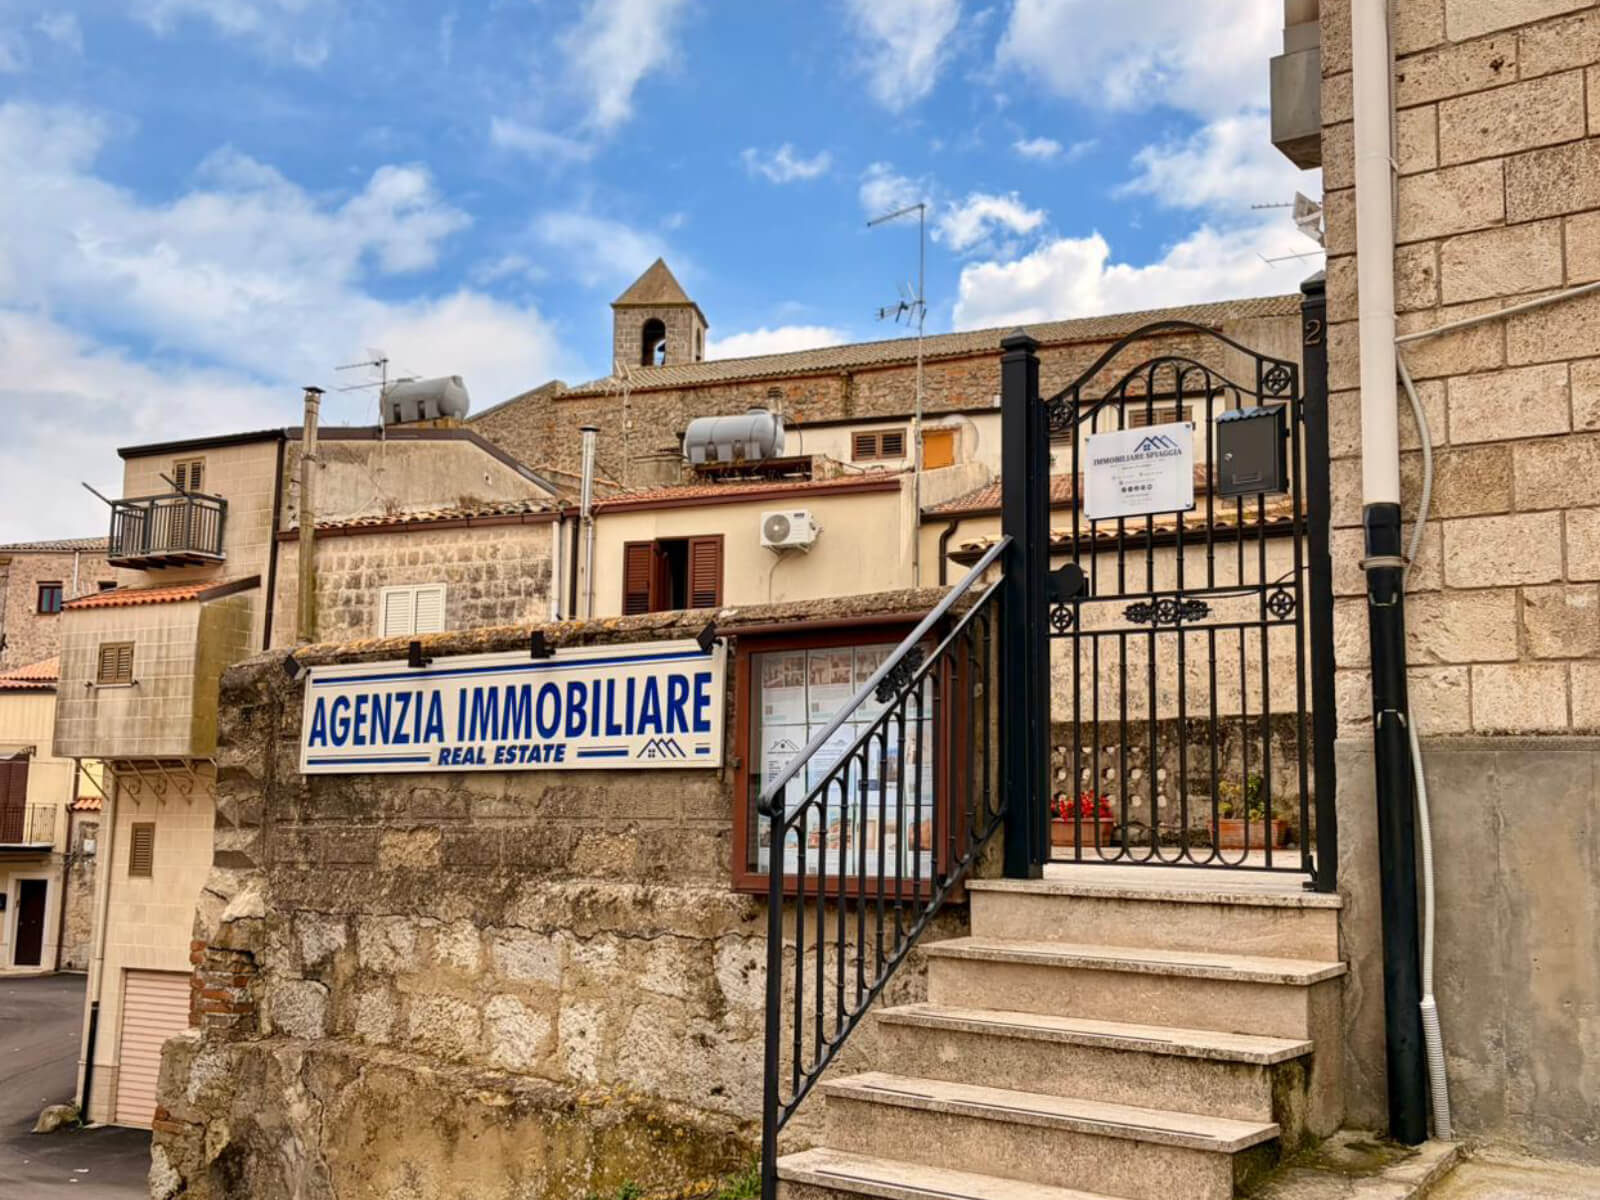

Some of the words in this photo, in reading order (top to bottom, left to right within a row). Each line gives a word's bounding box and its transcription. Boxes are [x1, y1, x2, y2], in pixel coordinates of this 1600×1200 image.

[1304, 319, 1321, 345] 2
[1094, 453, 1144, 466] IMMOBILIARE
[308, 689, 444, 747] AGENZIA
[457, 672, 712, 741] IMMOBILIARE
[438, 746, 486, 765] REAL
[494, 743, 566, 764] ESTATE
